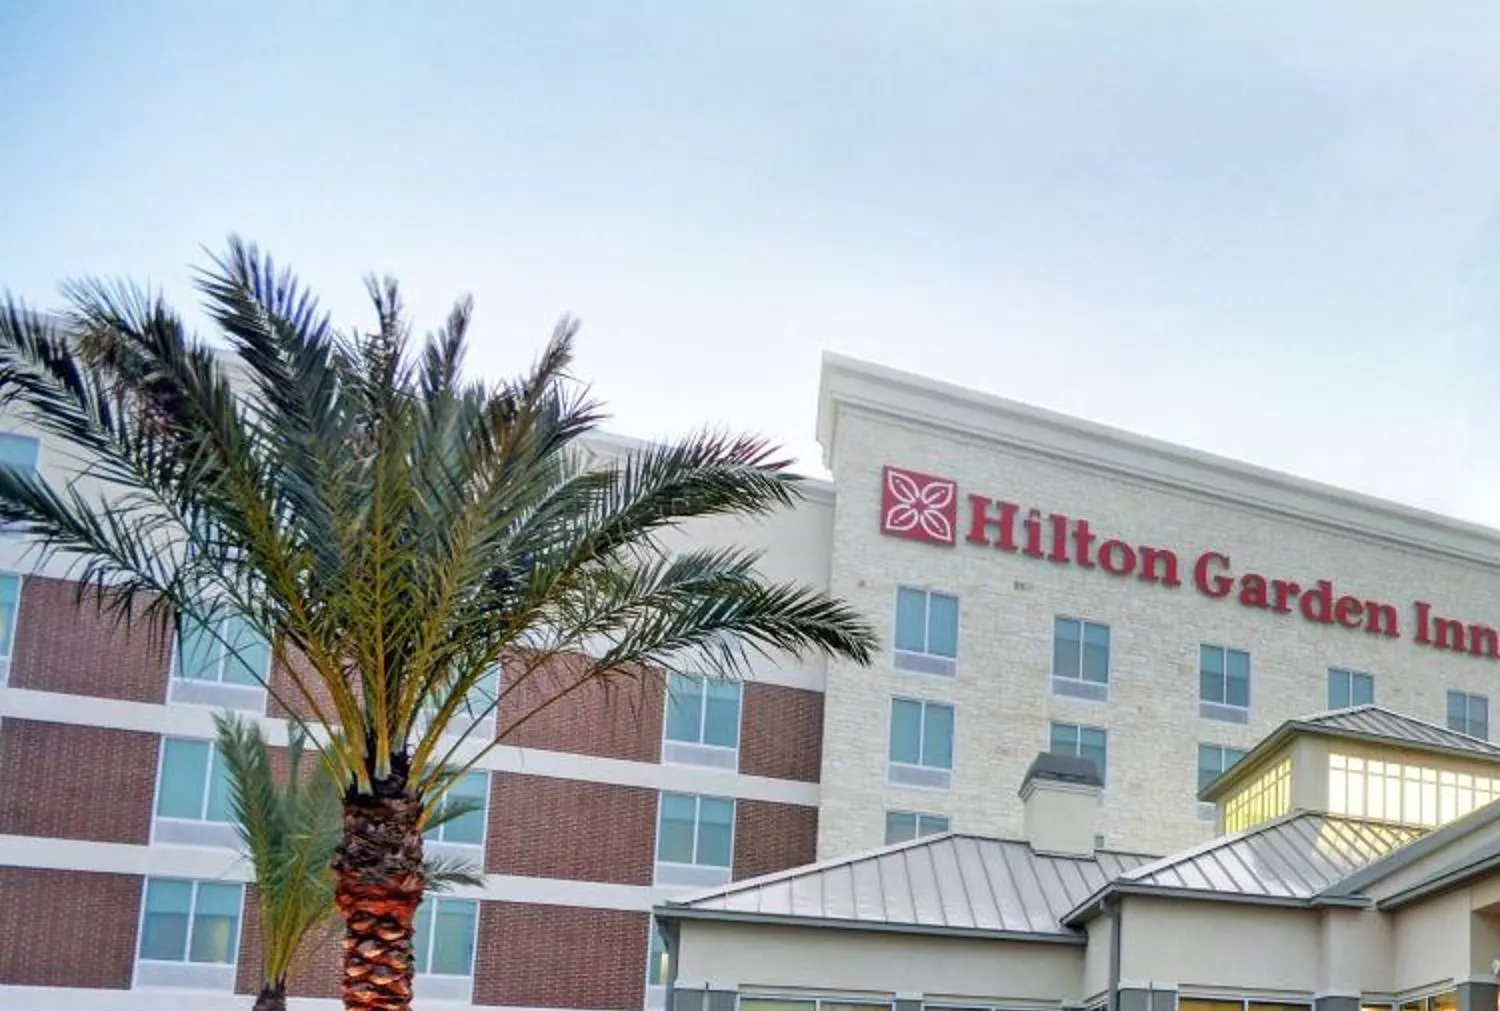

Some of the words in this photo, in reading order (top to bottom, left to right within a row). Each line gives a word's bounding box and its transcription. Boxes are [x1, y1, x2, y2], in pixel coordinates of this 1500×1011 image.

[967, 494, 1180, 586] Hilton
[1194, 550, 1400, 638] Garden
[1412, 600, 1500, 659] Inn
